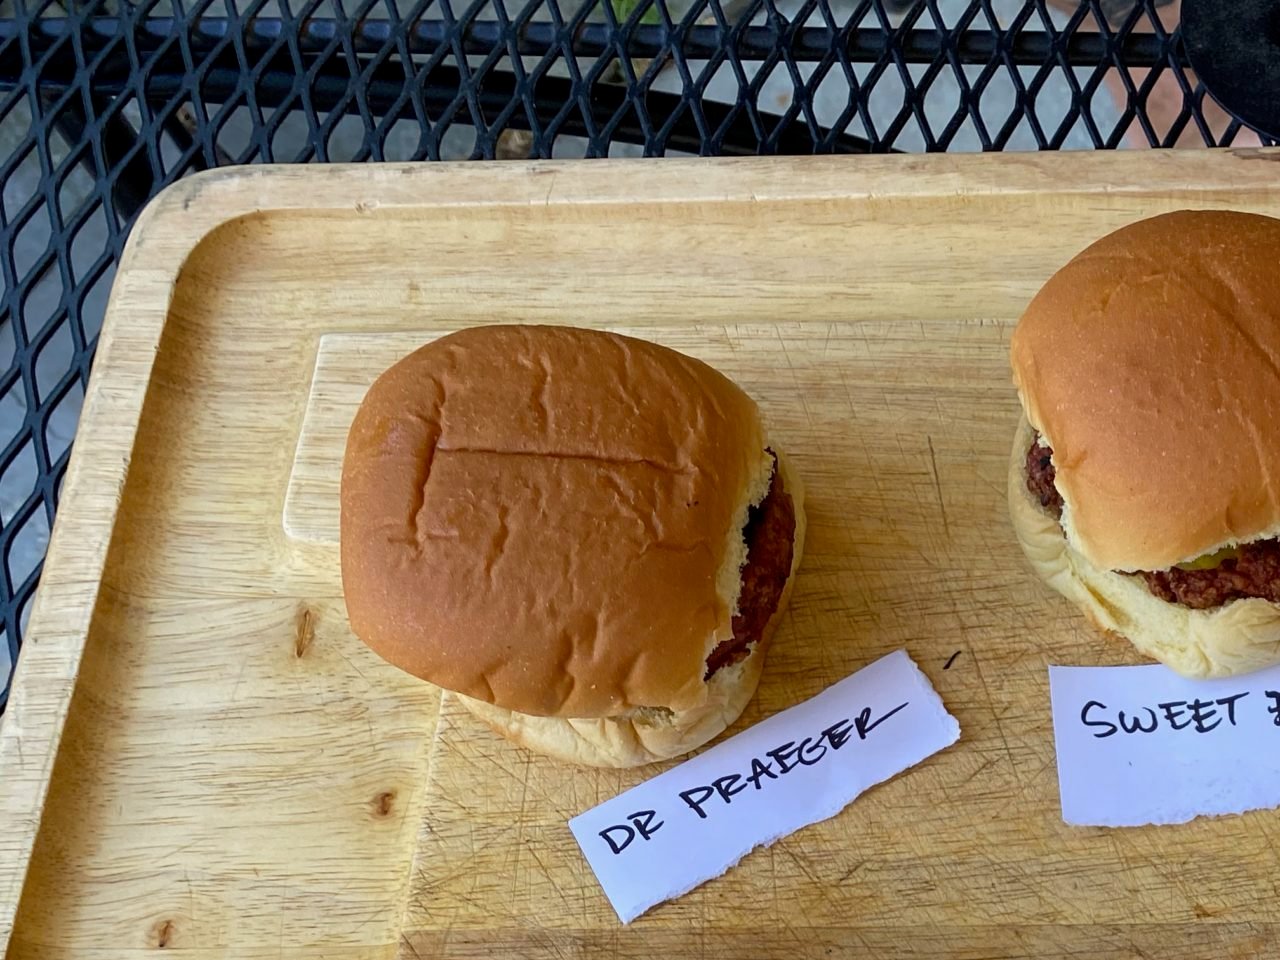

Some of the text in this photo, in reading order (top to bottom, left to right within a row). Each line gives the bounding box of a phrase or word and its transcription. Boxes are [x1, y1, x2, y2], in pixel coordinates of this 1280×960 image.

[1080, 690, 1250, 738] SWEET
[598, 701, 909, 855] DR PRAEGER
